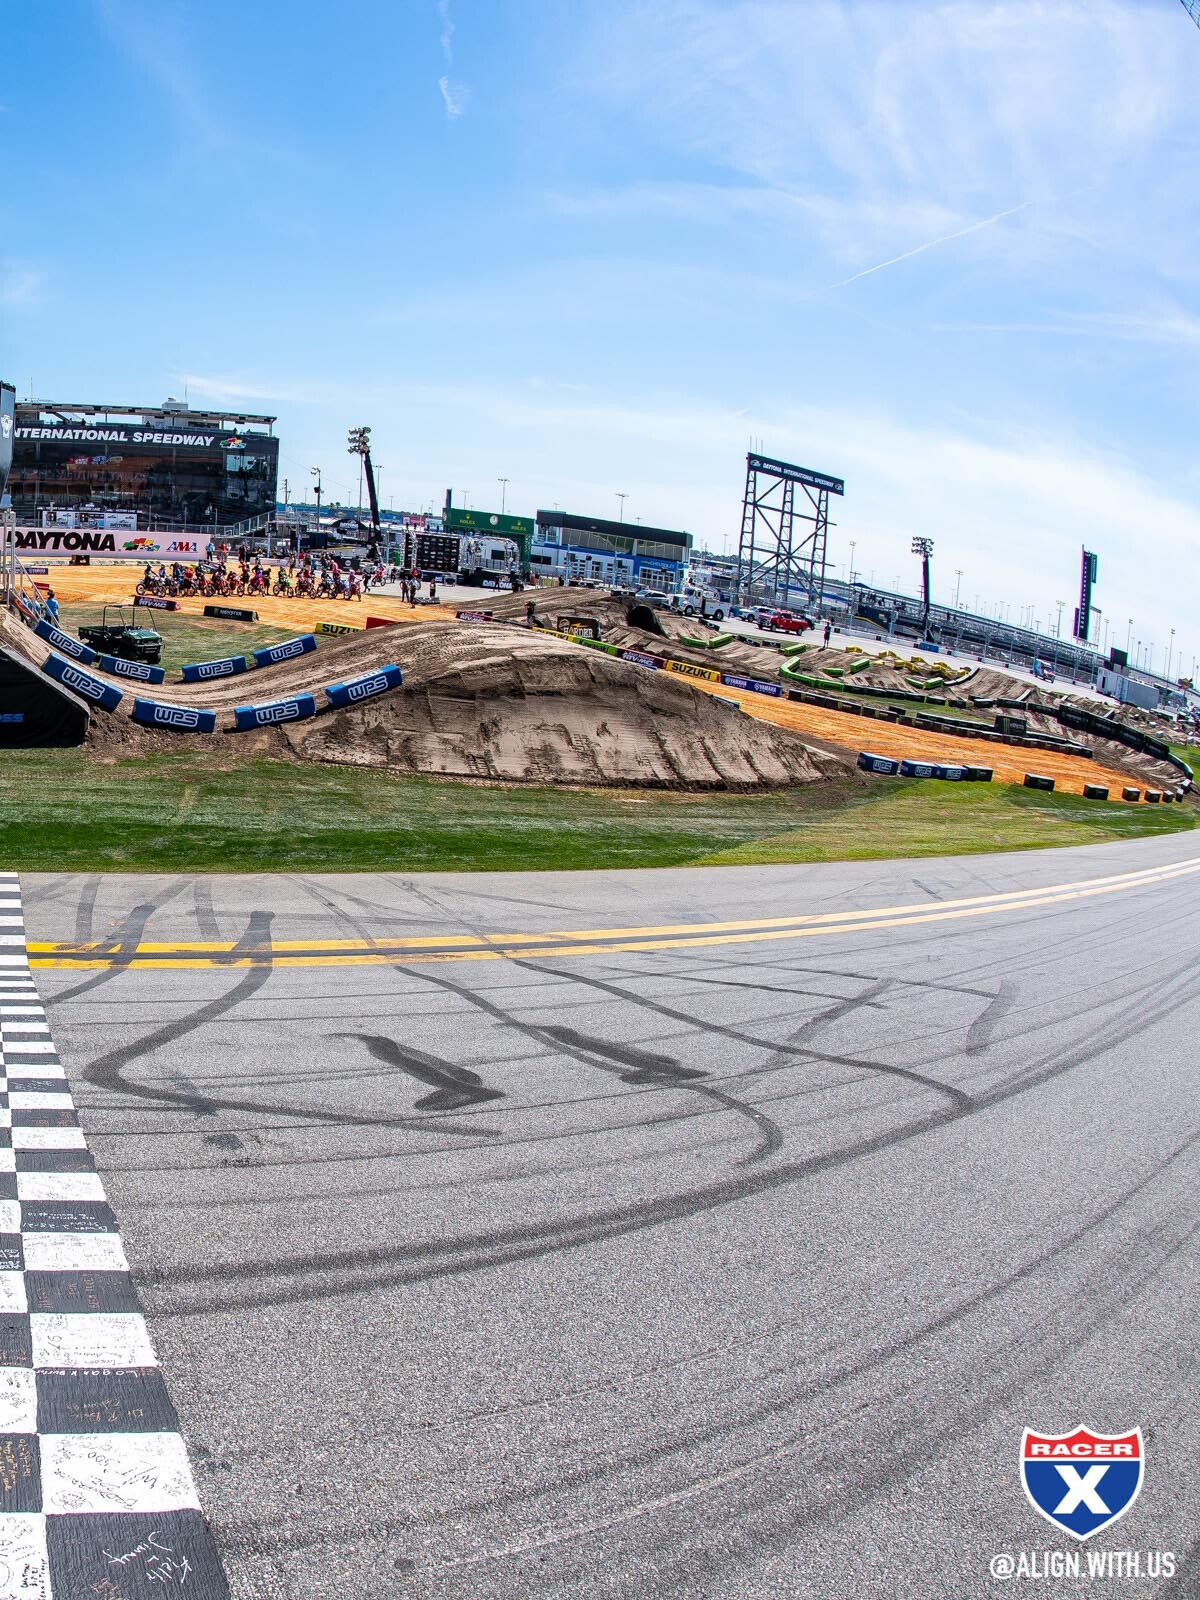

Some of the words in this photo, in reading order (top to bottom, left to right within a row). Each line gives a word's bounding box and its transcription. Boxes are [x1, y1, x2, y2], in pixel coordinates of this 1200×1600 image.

[13, 428, 128, 442] NTERNATIONAL
[133, 432, 214, 447] SPEEDWAY
[6, 531, 116, 552] DAYTONA
[166, 541, 198, 552] AMA
[482, 579, 513, 590] DAYONA
[563, 627, 593, 639] HARDER
[48, 630, 83, 657] WPS
[271, 642, 304, 661] WPS
[114, 660, 151, 679] WPS
[199, 661, 234, 678] WPS
[672, 663, 712, 680] SUZUKI
[62, 667, 105, 699] WPS
[349, 676, 390, 701] WPS
[154, 707, 199, 728] WPS
[256, 703, 299, 724] WPS
[873, 759, 893, 773] WPS
[914, 765, 932, 777] WPS
[947, 769, 962, 780] WPS
[84, 1368, 138, 1379] Logan
[102, 1530, 173, 1565] Jimmy
[146, 1555, 192, 1583] Kelly
